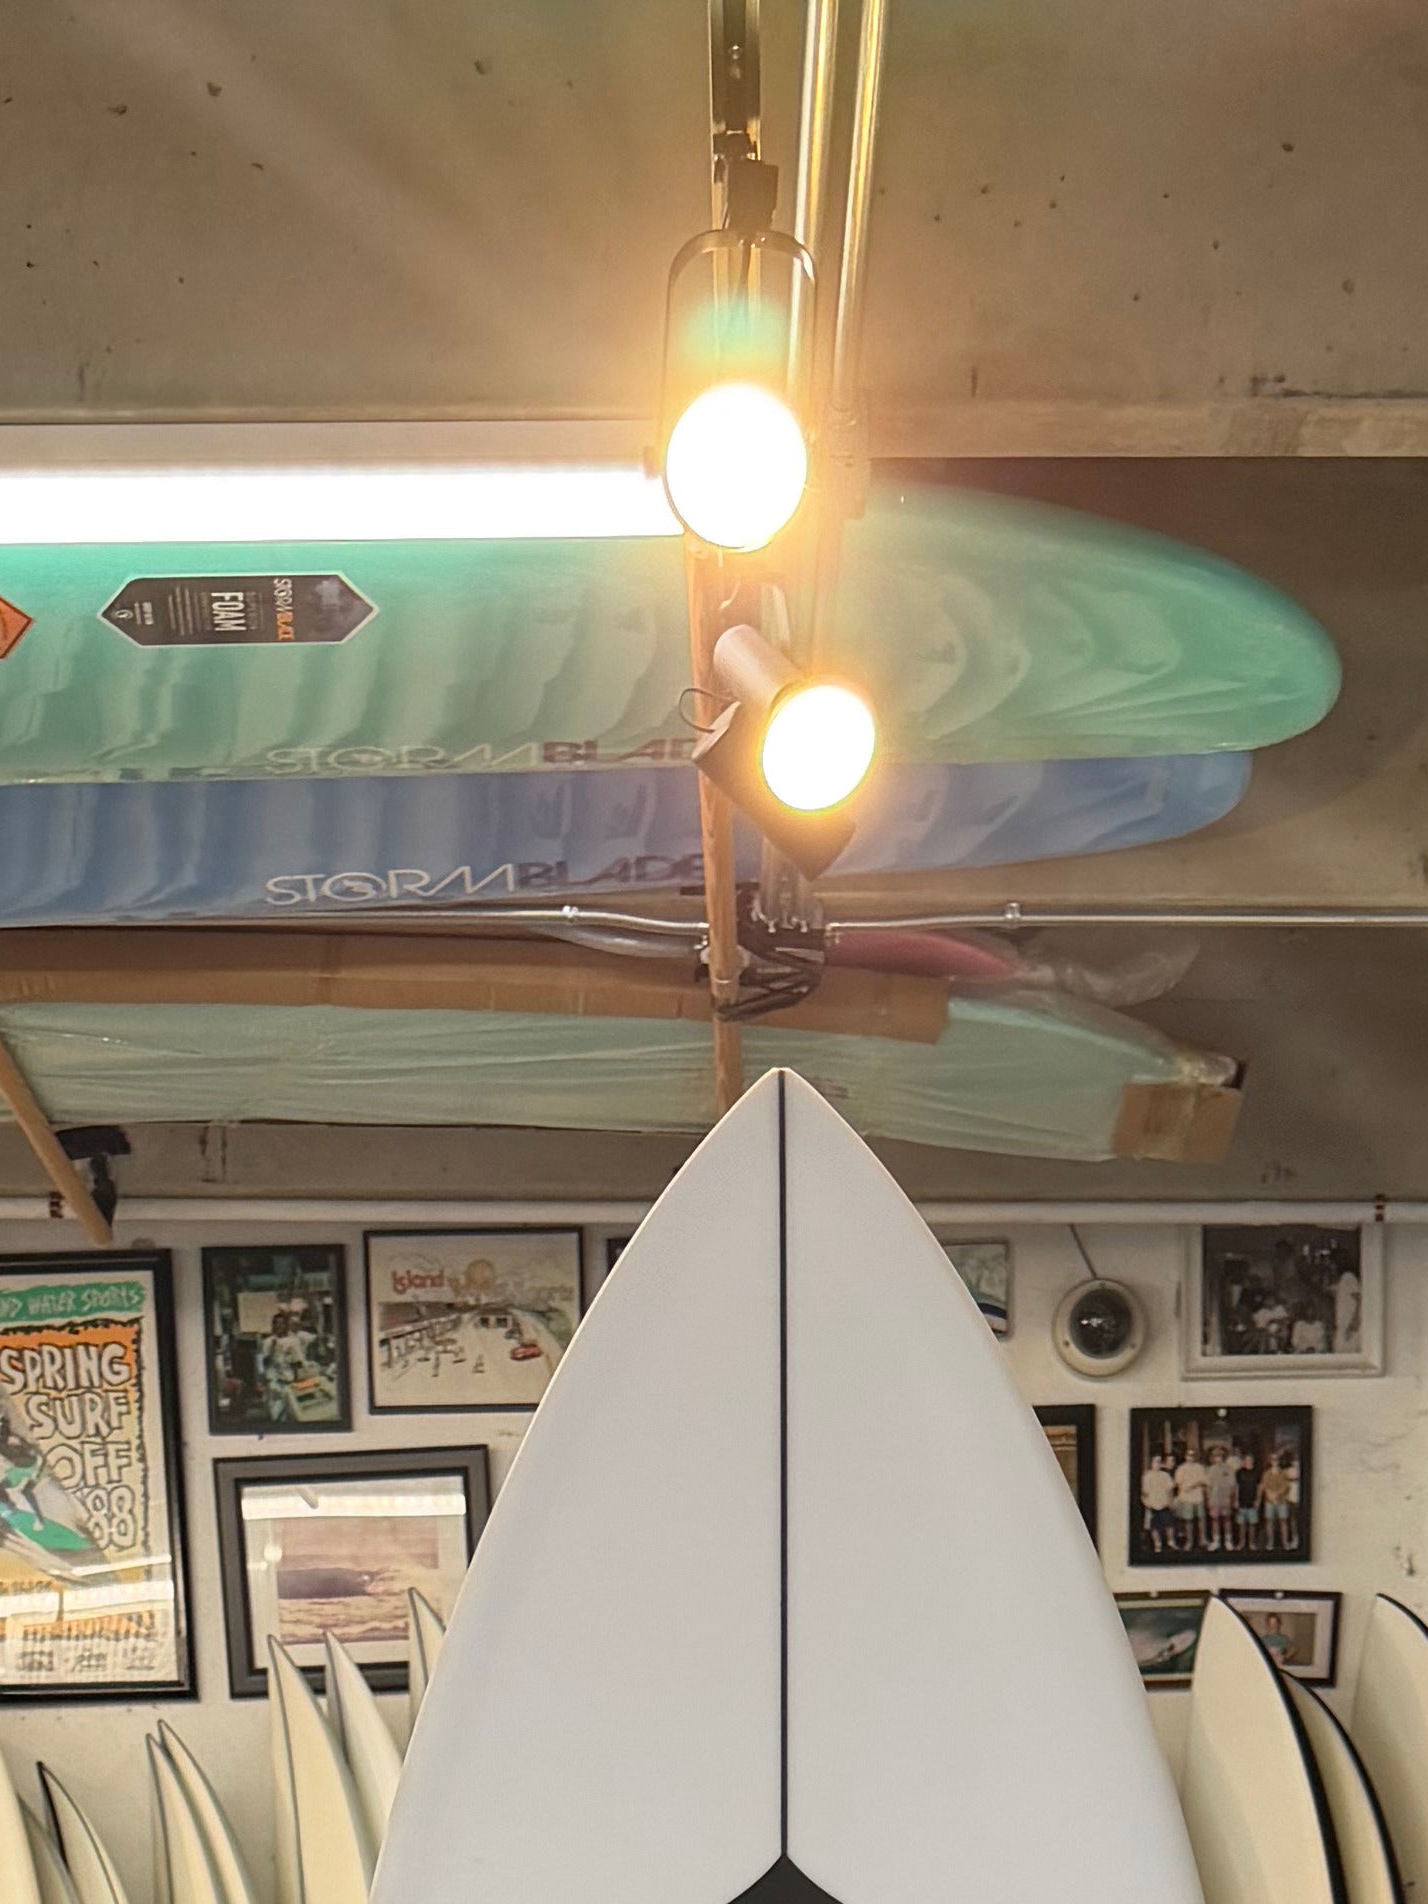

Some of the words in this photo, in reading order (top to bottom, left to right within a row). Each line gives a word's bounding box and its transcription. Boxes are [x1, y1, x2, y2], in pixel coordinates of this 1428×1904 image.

[210, 591, 247, 633] FOAM
[27, 1292, 76, 1314] WATER
[81, 1285, 139, 1312] SPORTS
[25, 1388, 134, 1441] SURF
[42, 1440, 134, 1490] OFF
